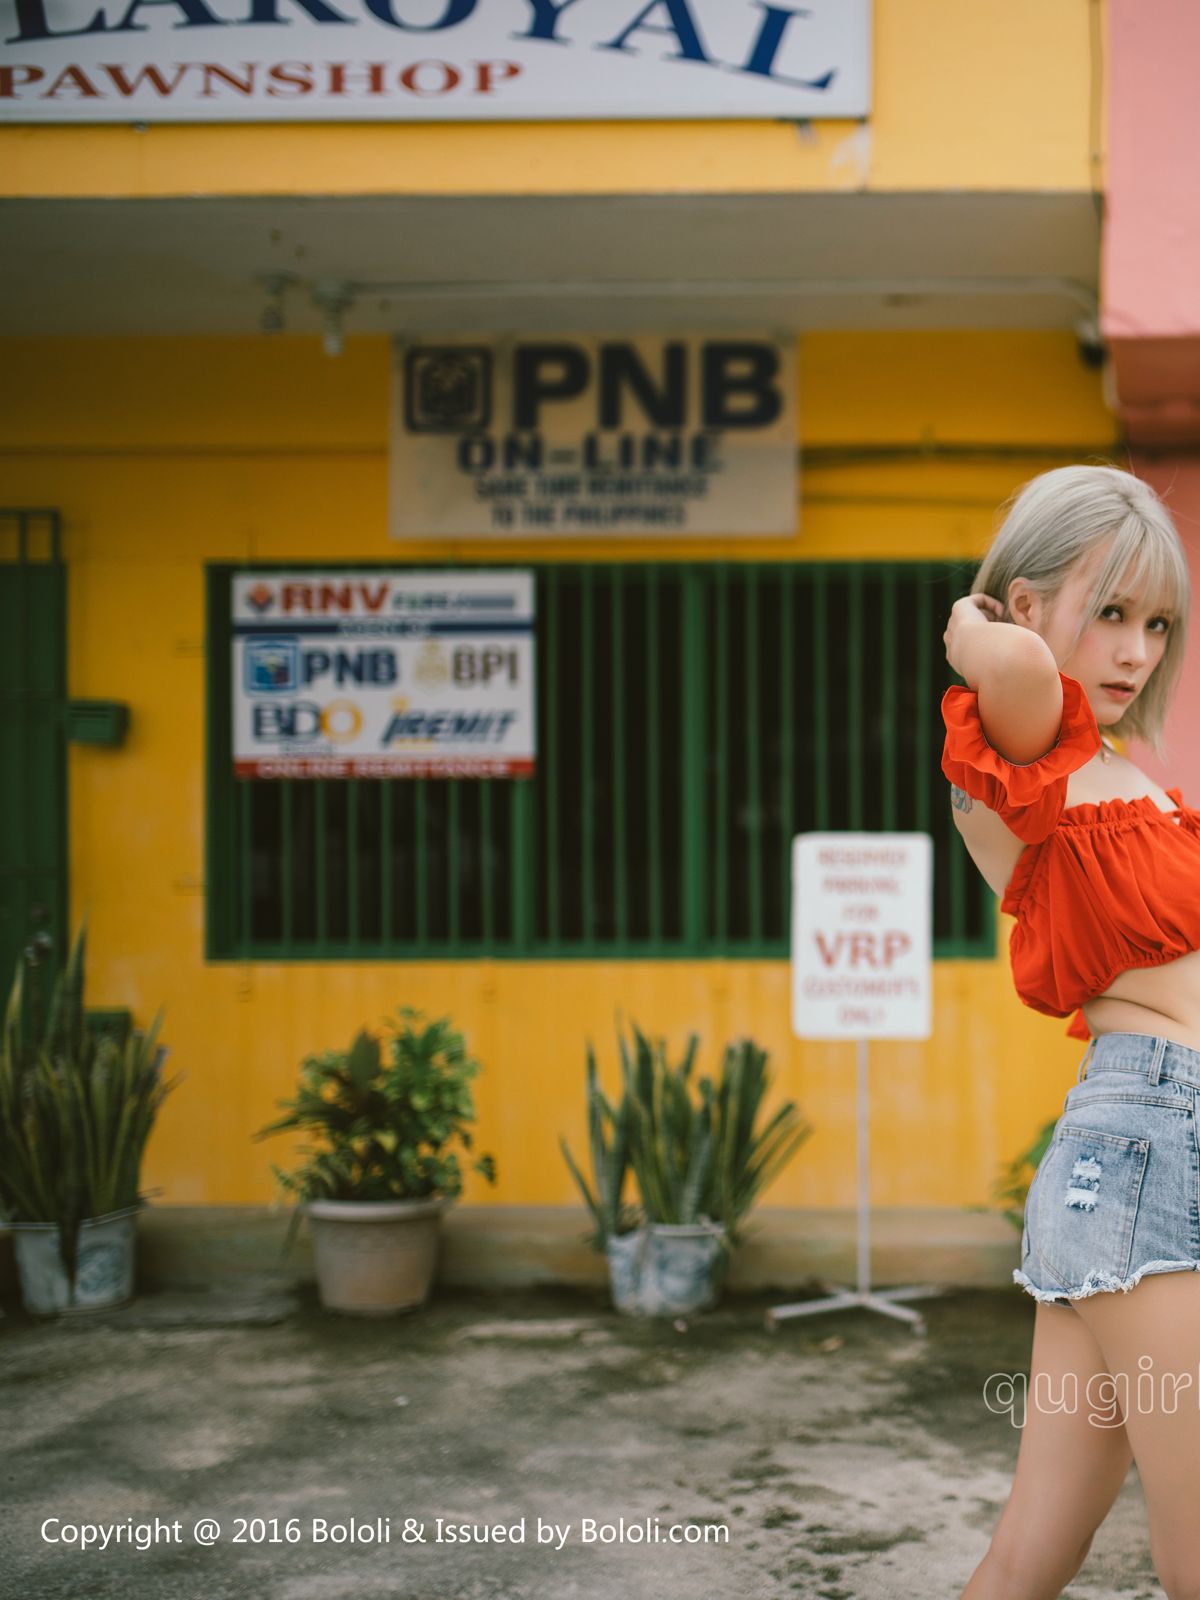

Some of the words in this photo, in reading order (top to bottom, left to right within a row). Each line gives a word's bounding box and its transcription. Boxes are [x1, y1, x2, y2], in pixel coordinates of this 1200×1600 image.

[0, 60, 524, 98] PAWNSHOP
[513, 342, 784, 431] PNB
[457, 432, 723, 474] ON-LINE
[280, 581, 391, 614] RNV
[302, 649, 398, 685] PNB
[453, 648, 518, 686] BPI
[252, 698, 363, 743] BDO
[815, 930, 913, 969] VRP
